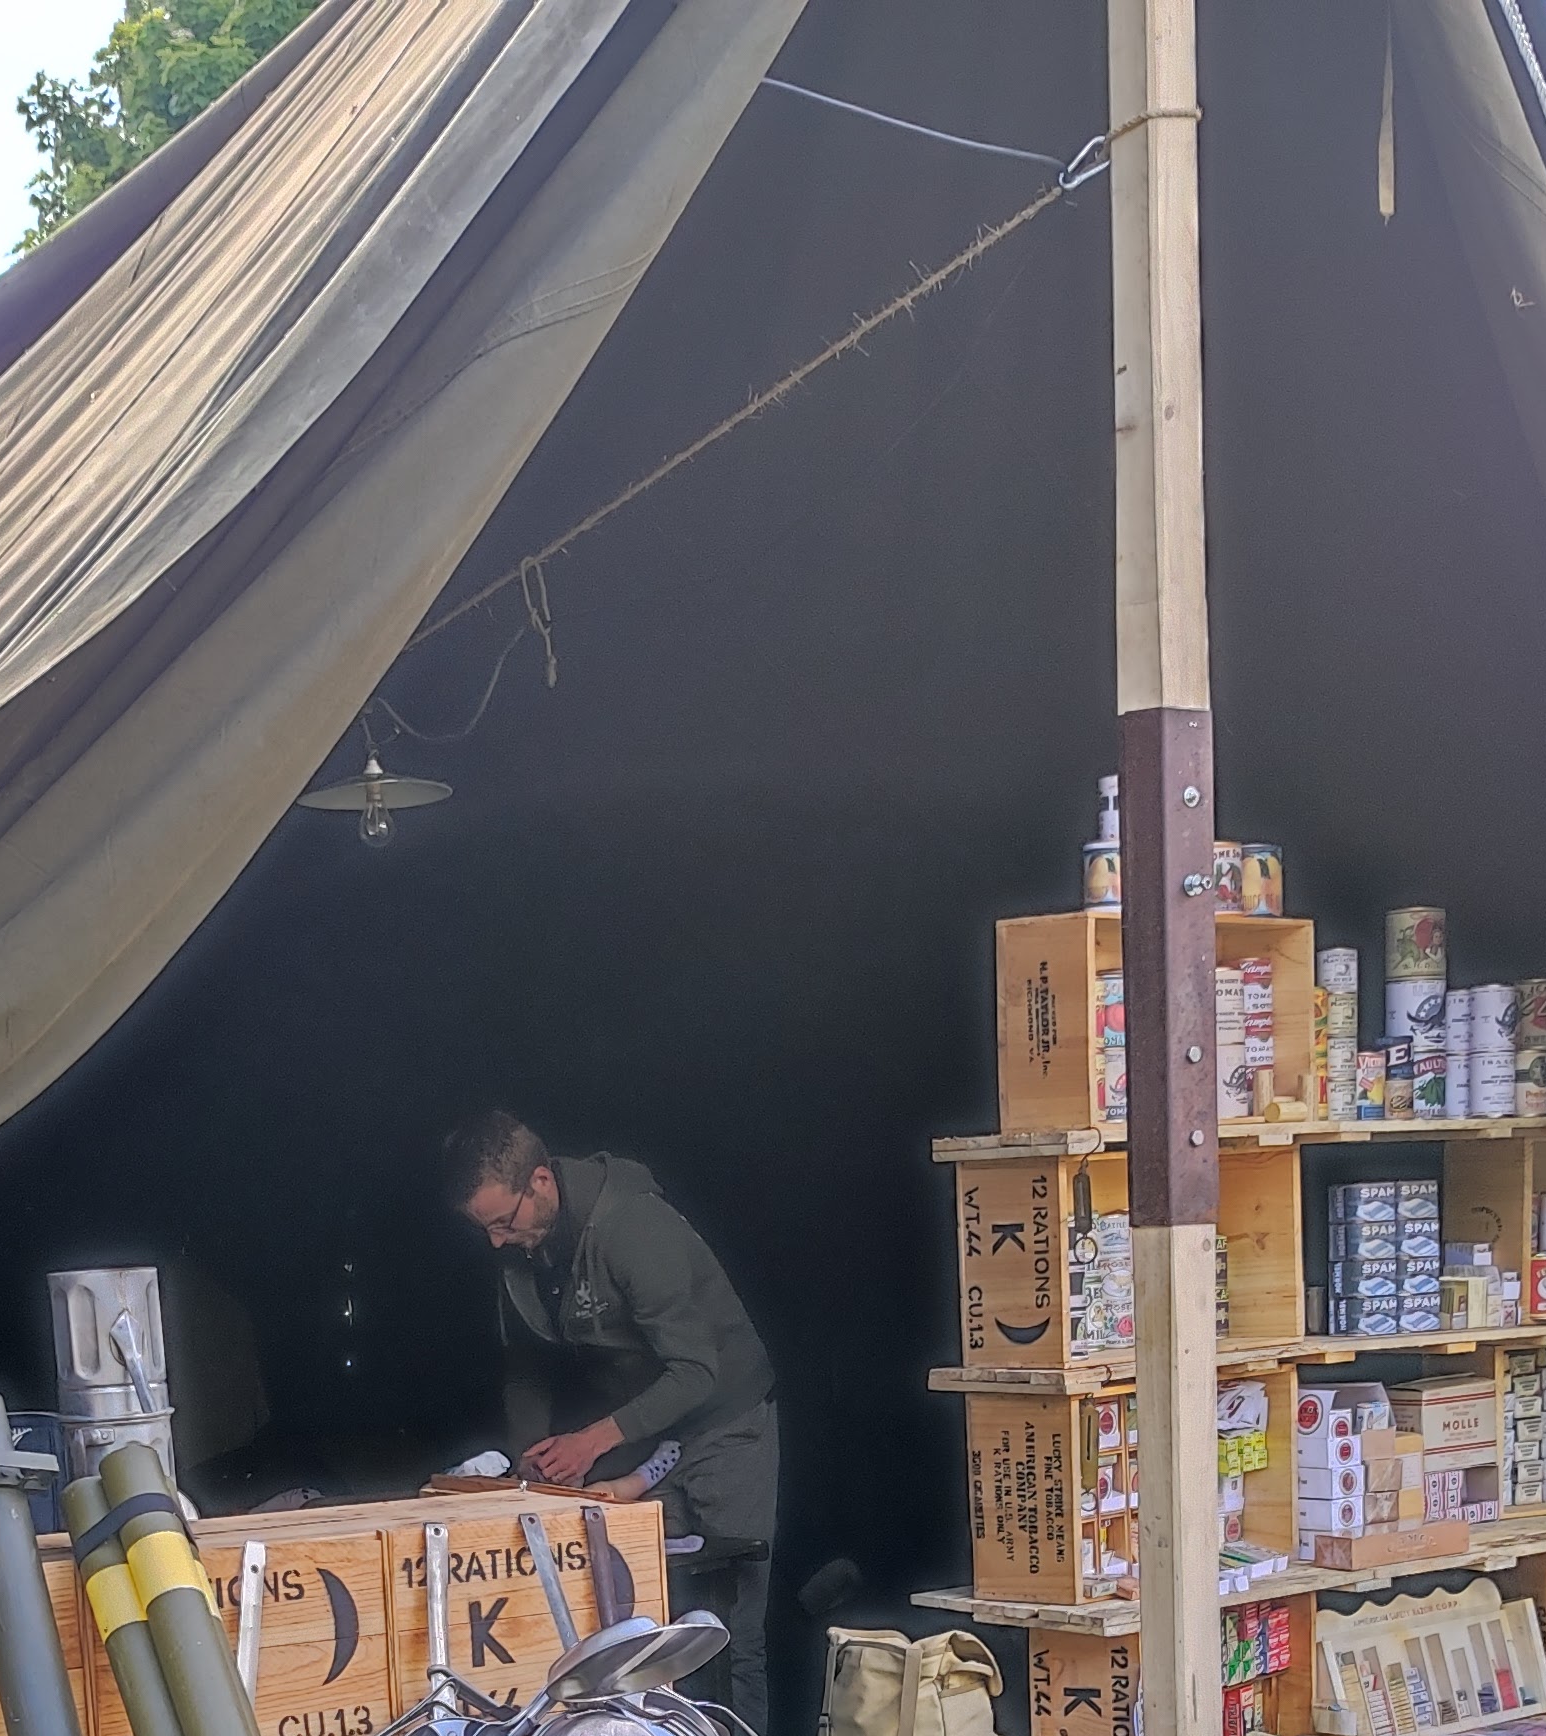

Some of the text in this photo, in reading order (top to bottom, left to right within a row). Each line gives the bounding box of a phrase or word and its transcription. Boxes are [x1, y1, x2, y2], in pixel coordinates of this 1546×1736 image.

[1360, 1187, 1395, 1198] SPAM
[1401, 1184, 1437, 1195] SPAM
[964, 1186, 982, 1258] WT.44
[1361, 1225, 1396, 1236] SPAM
[1404, 1222, 1439, 1234] SPAM
[991, 1222, 1026, 1256] K
[1032, 1174, 1051, 1309] 12 RATIONS
[1362, 1263, 1396, 1275] SPAM
[1407, 1260, 1439, 1272] SPAM
[1362, 1299, 1397, 1311] SPAM
[1403, 1296, 1440, 1308] SPAM
[1442, 1418, 1479, 1430] MOLLE
[1002, 1457, 1012, 1480] USE
[1052, 1433, 1062, 1473] LUCKY
[993, 1462, 1004, 1512] RATIONS
[1003, 1485, 1012, 1497] IN
[1015, 1460, 1028, 1533] COMPANY
[1025, 1421, 1039, 1575] AMERICAN TOBACCO
[1044, 1456, 1055, 1541] FINE TOBACCO
[1054, 1479, 1064, 1519] STRIKE
[449, 1541, 586, 1584] RATIONS
[468, 1597, 516, 1668] K
[1110, 1646, 1129, 1669] 12
[1033, 1649, 1052, 1717] WT.44
[1063, 1687, 1102, 1718] K
